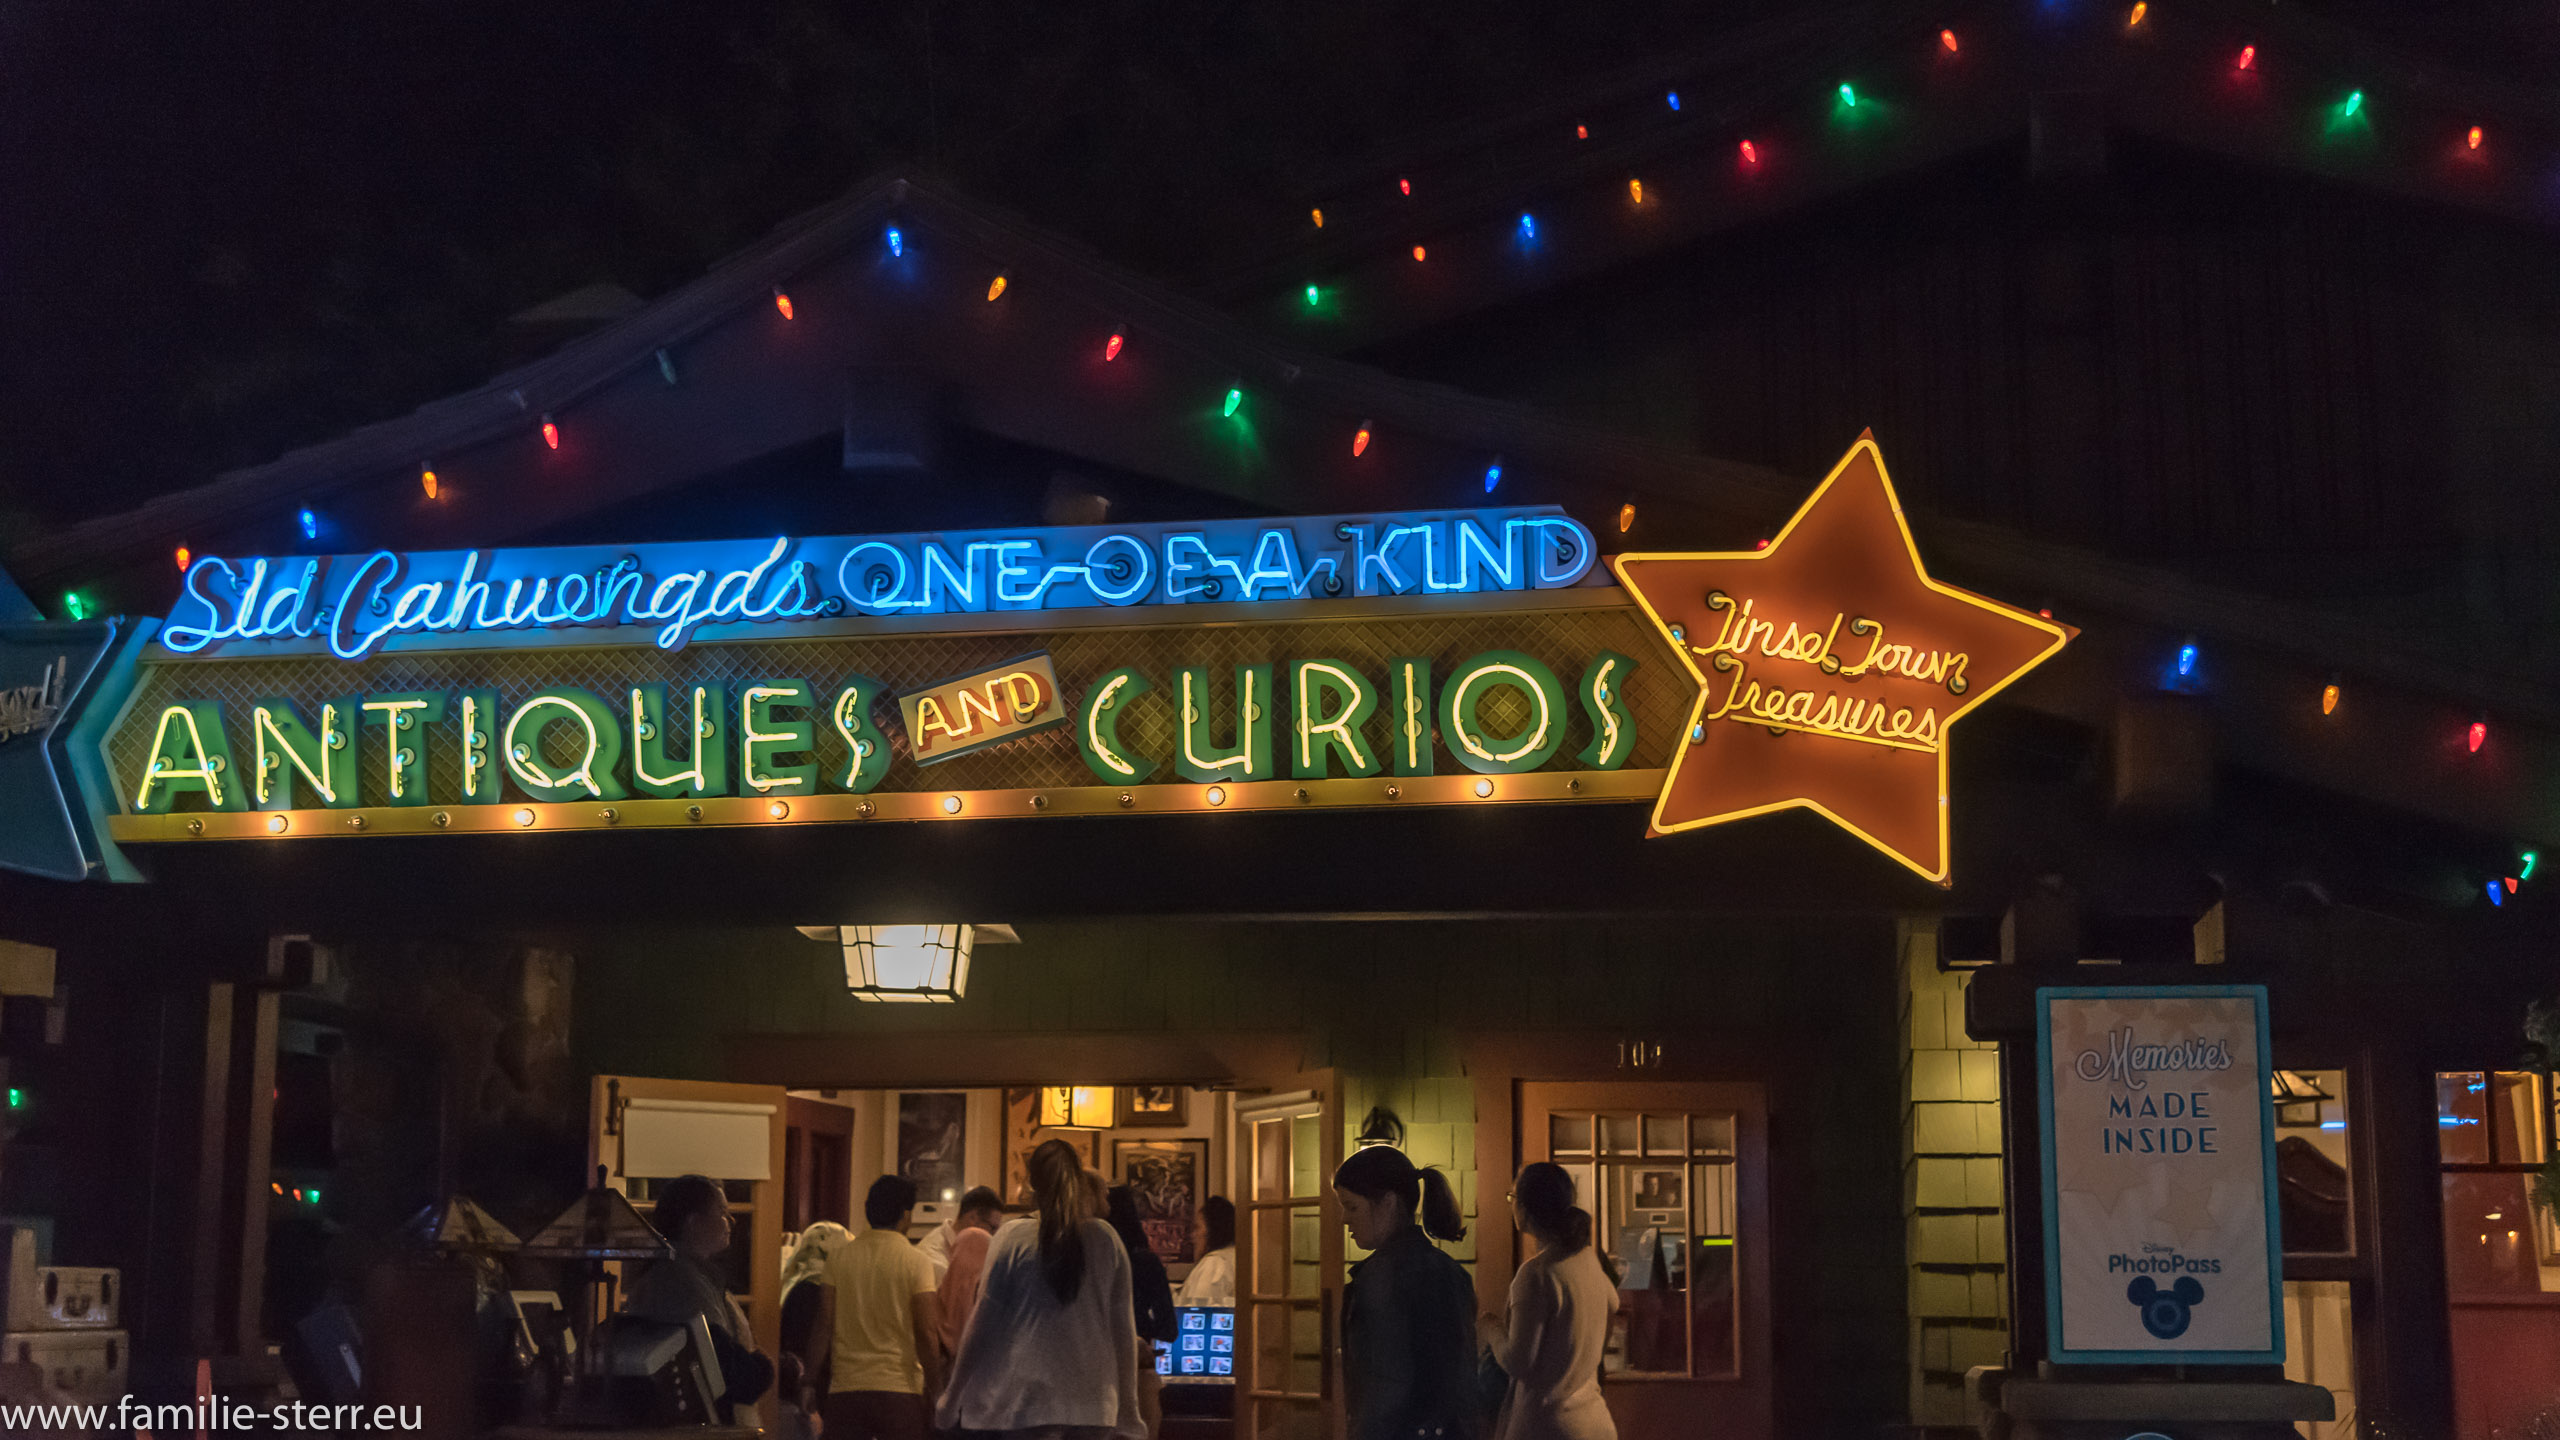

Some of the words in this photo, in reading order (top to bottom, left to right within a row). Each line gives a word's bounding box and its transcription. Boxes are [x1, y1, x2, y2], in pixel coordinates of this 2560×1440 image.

[1693, 596, 1839, 671] Tinsel
[1840, 618, 1969, 686] Town
[138, 676, 890, 810] ANTIQUES
[916, 670, 1053, 750] AND
[1079, 652, 1634, 783] CURIOS
[1707, 656, 1938, 746] Treasures
[2075, 1026, 2233, 1091] Memories
[2108, 1092, 2210, 1119] MADE
[2102, 1126, 2219, 1155] INSIDE
[2108, 1253, 2222, 1274] PhotoPass
